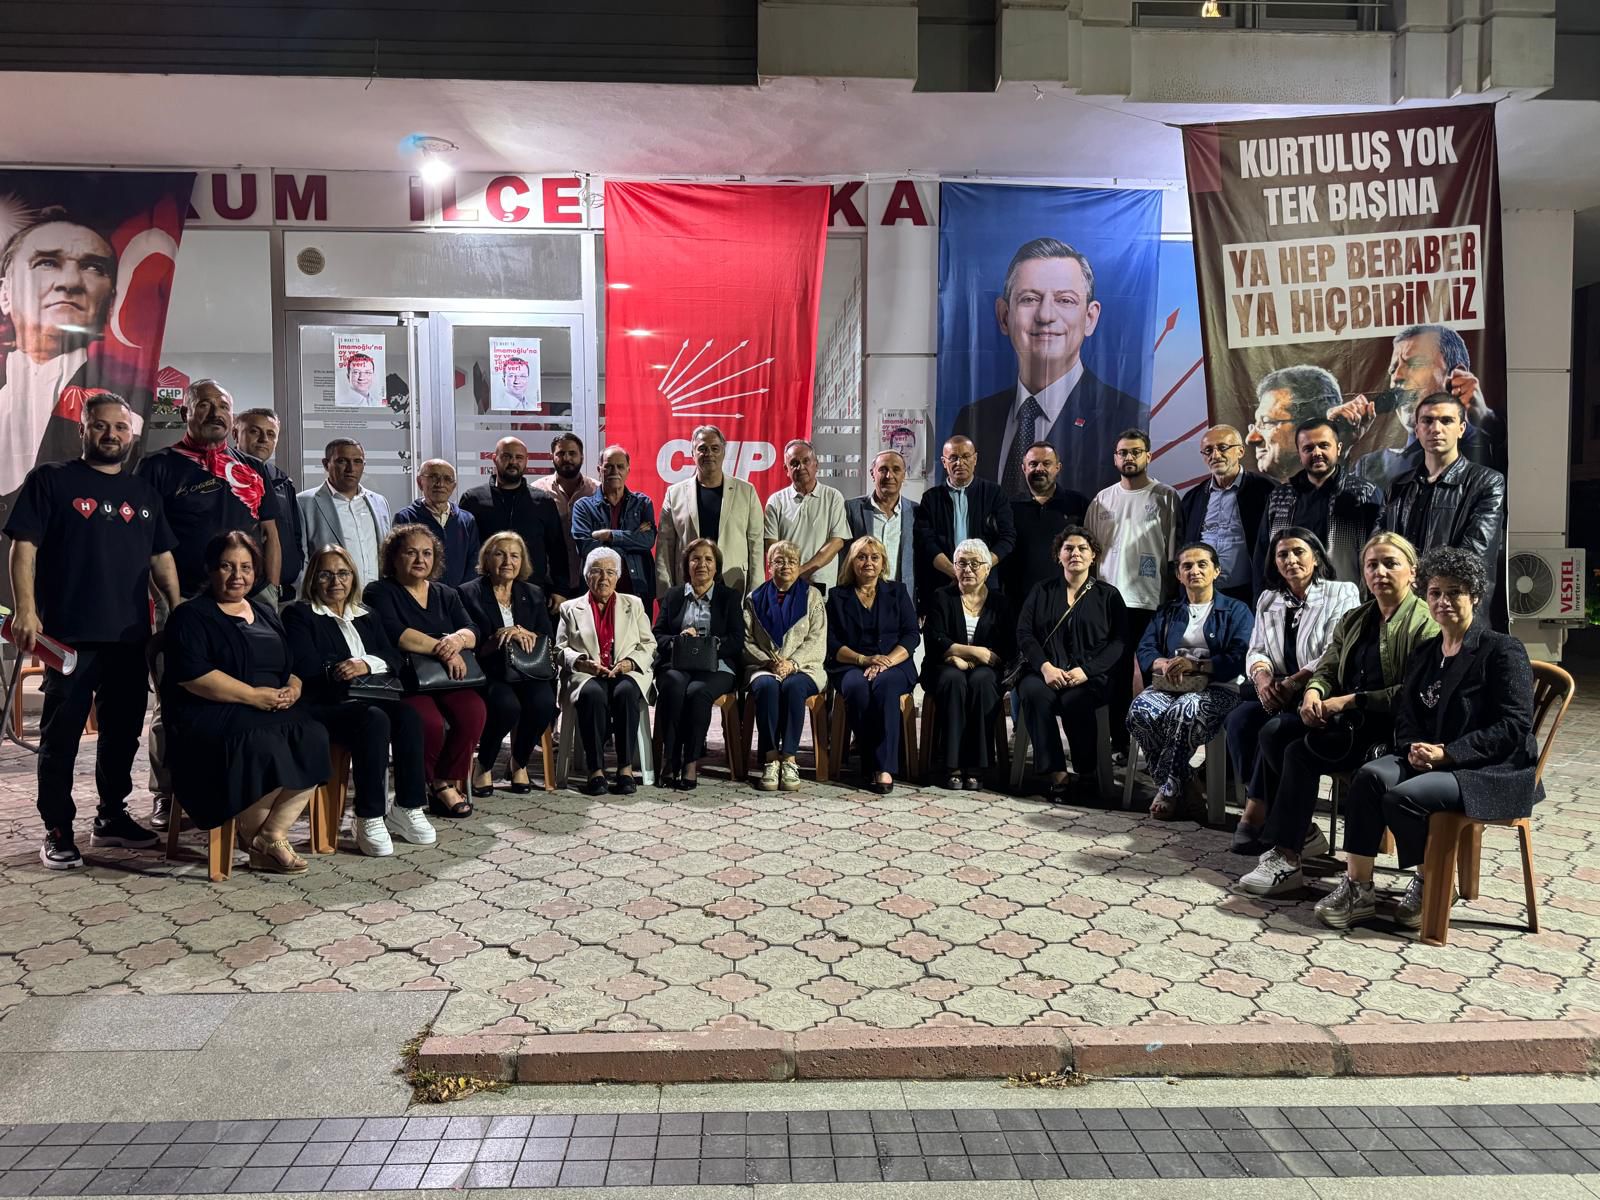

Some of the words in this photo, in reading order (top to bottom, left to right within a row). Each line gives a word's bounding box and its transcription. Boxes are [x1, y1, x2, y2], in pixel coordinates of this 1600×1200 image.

[1239, 131, 1391, 178] KURTULUŞ
[1396, 126, 1458, 167] YOK
[1263, 185, 1319, 226] TEK
[1328, 177, 1439, 222] BAŞINA
[1229, 248, 1270, 288] YA
[1278, 243, 1336, 284] HEP
[1346, 232, 1476, 280] BERABER
[1232, 292, 1279, 338] YA
[1290, 277, 1477, 336] HİÇBİRİMİZ
[159, 389, 181, 398] CHP
[81, 502, 149, 518] HUGO
[1561, 557, 1573, 613] VESTEL
